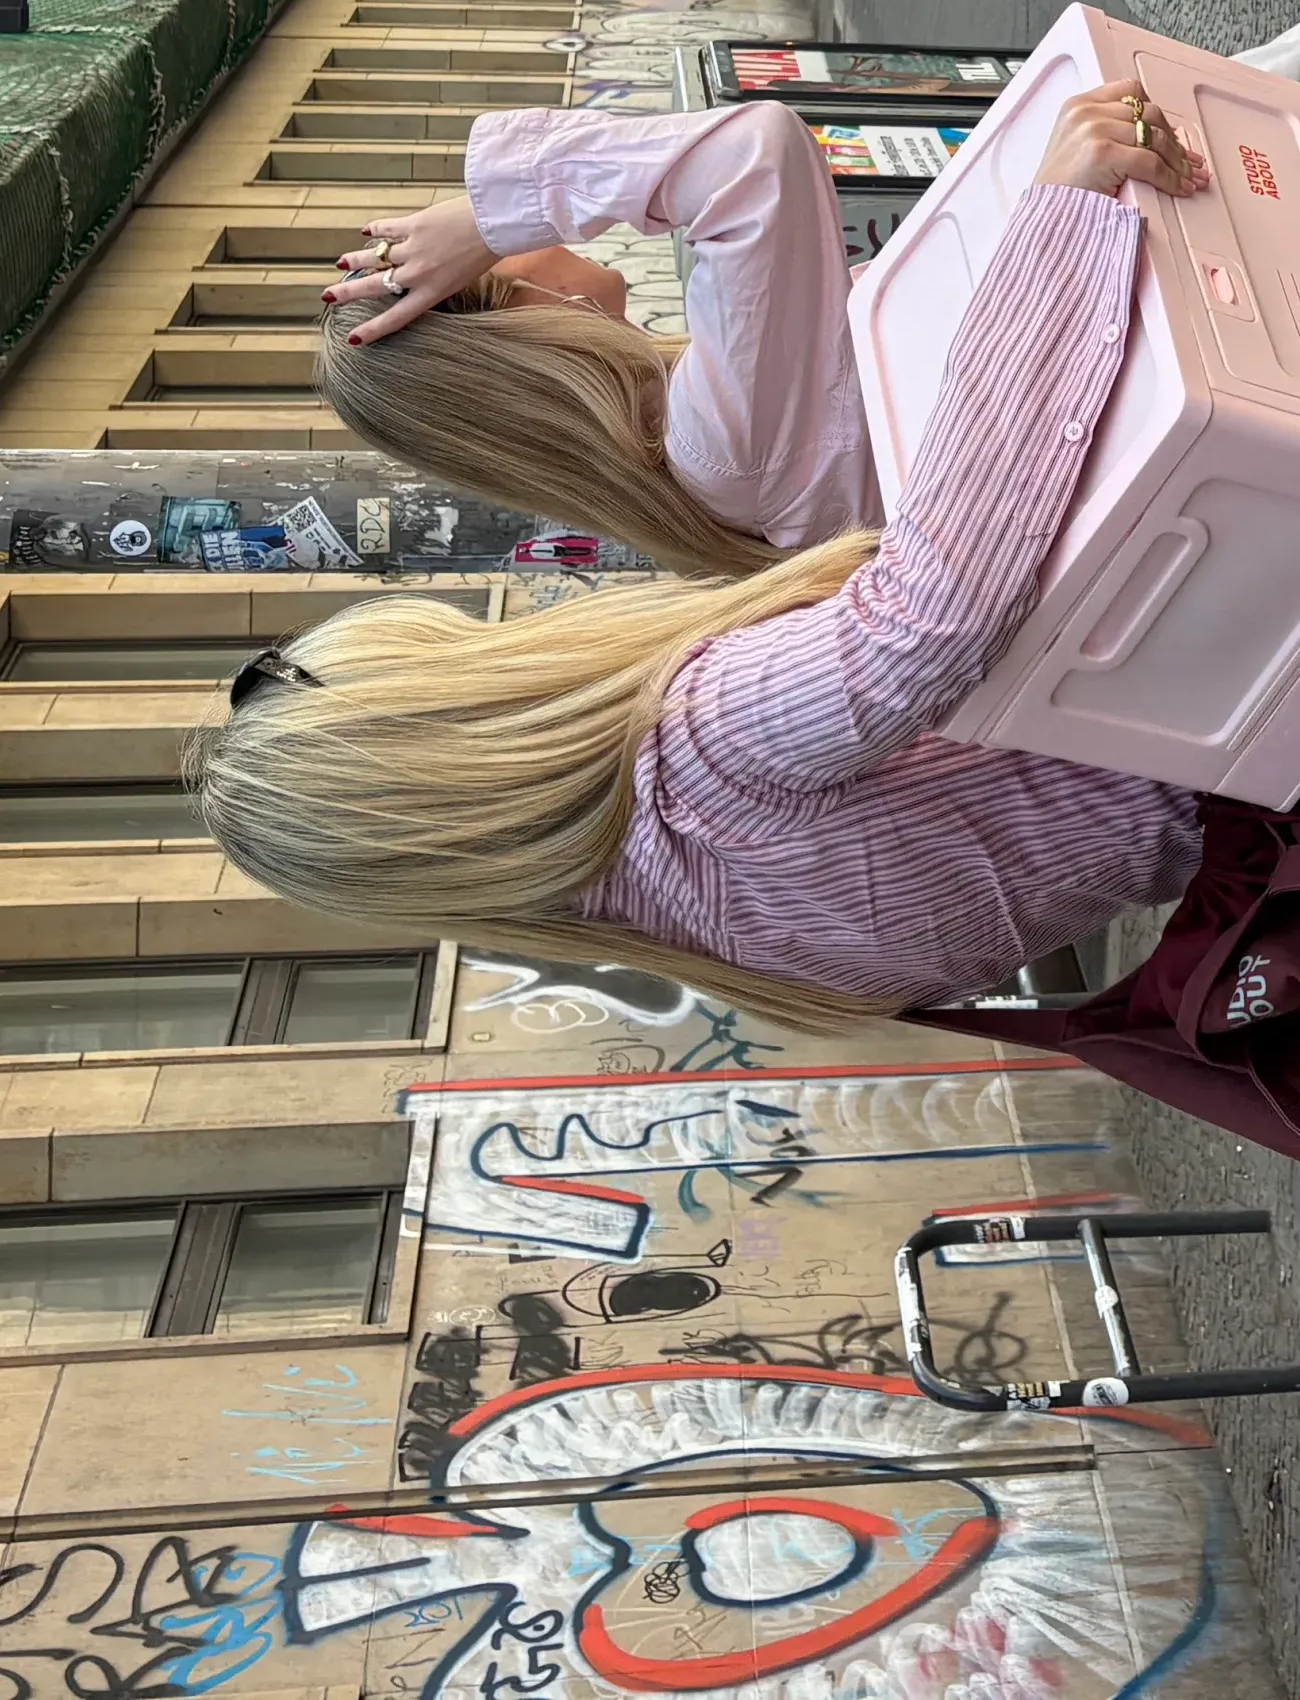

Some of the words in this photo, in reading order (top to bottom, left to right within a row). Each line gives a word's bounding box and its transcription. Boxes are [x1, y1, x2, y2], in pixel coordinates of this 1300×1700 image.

[1238, 144, 1265, 196] STUDIO
[1253, 148, 1281, 201] ABOUT
[203, 532, 221, 558] DIE
